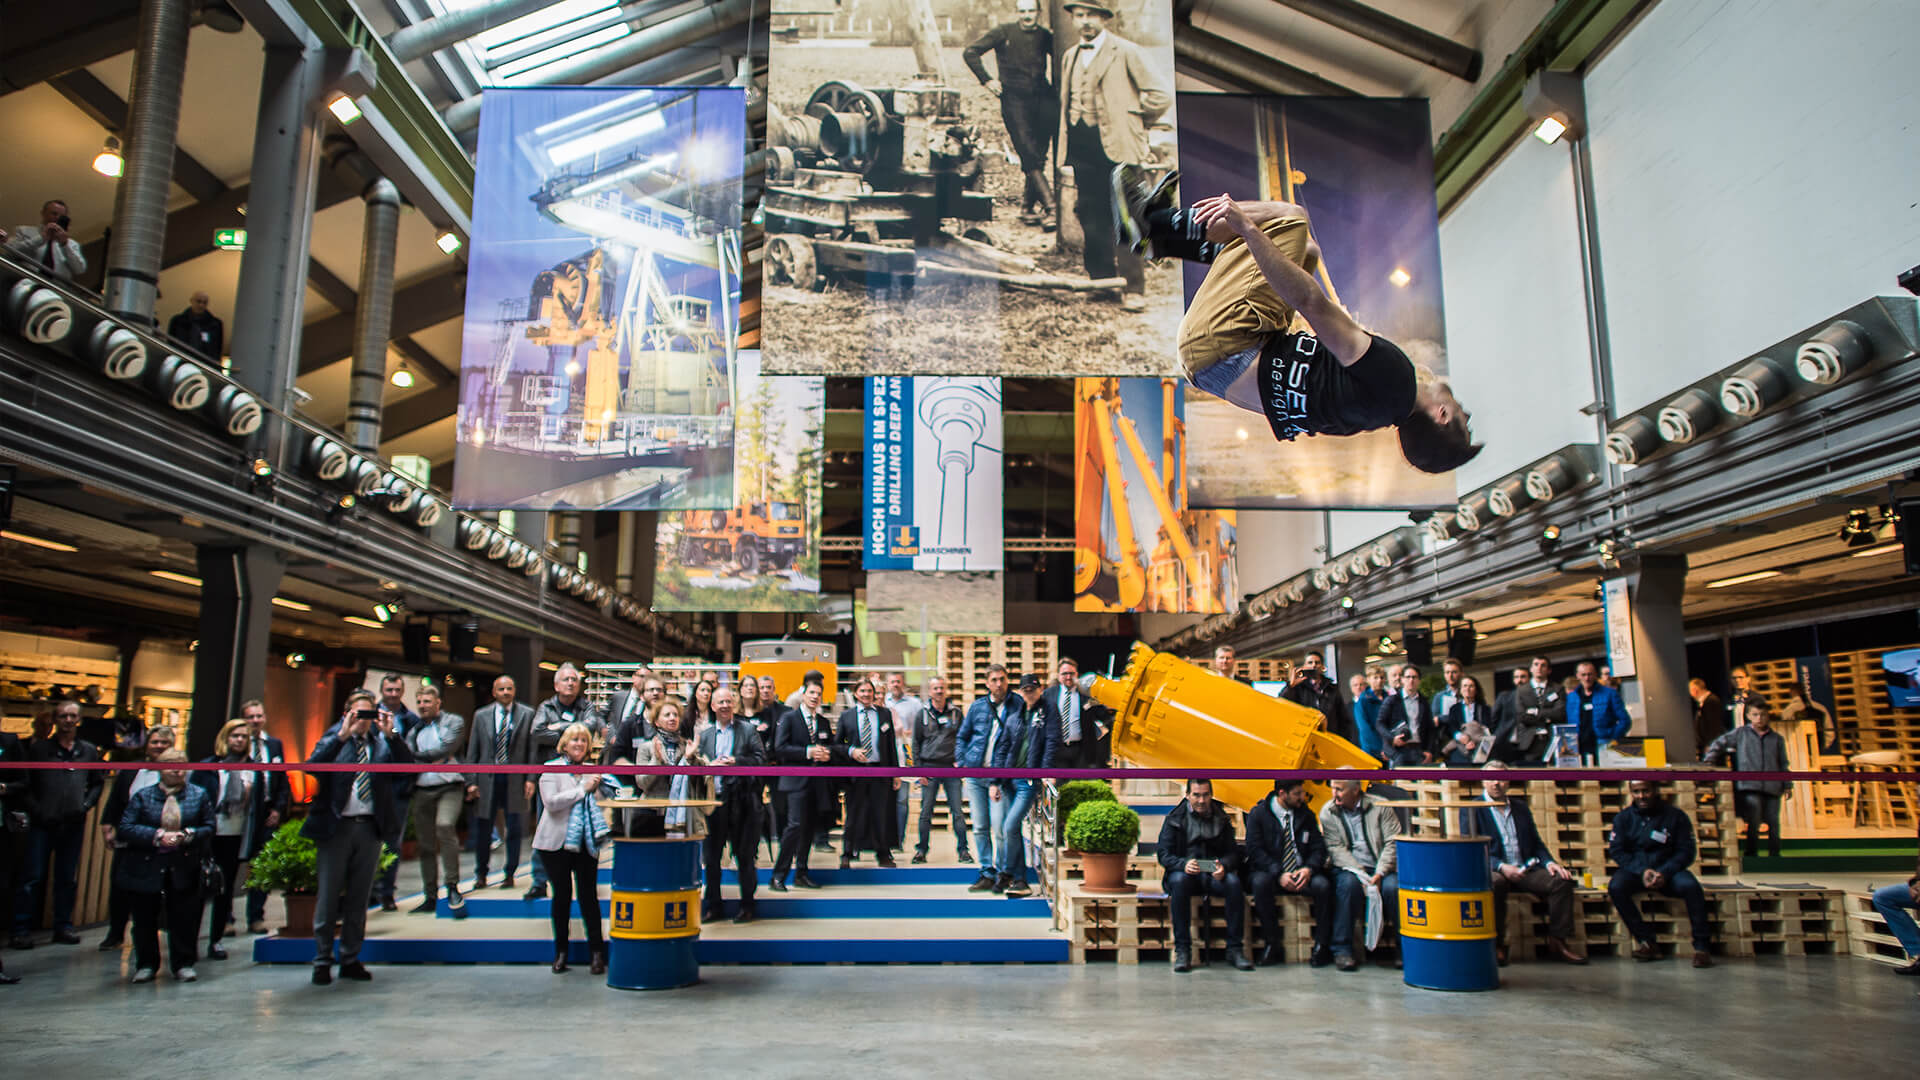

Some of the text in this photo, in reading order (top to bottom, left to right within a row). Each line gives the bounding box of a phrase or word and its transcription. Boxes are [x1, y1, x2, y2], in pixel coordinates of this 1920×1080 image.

[873, 420, 886, 440] IM
[888, 376, 902, 517] DRILLING DEEP AN
[872, 442, 886, 505] HINAUS
[872, 507, 886, 556] HOCH
[922, 546, 973, 555] MASCHINEN
